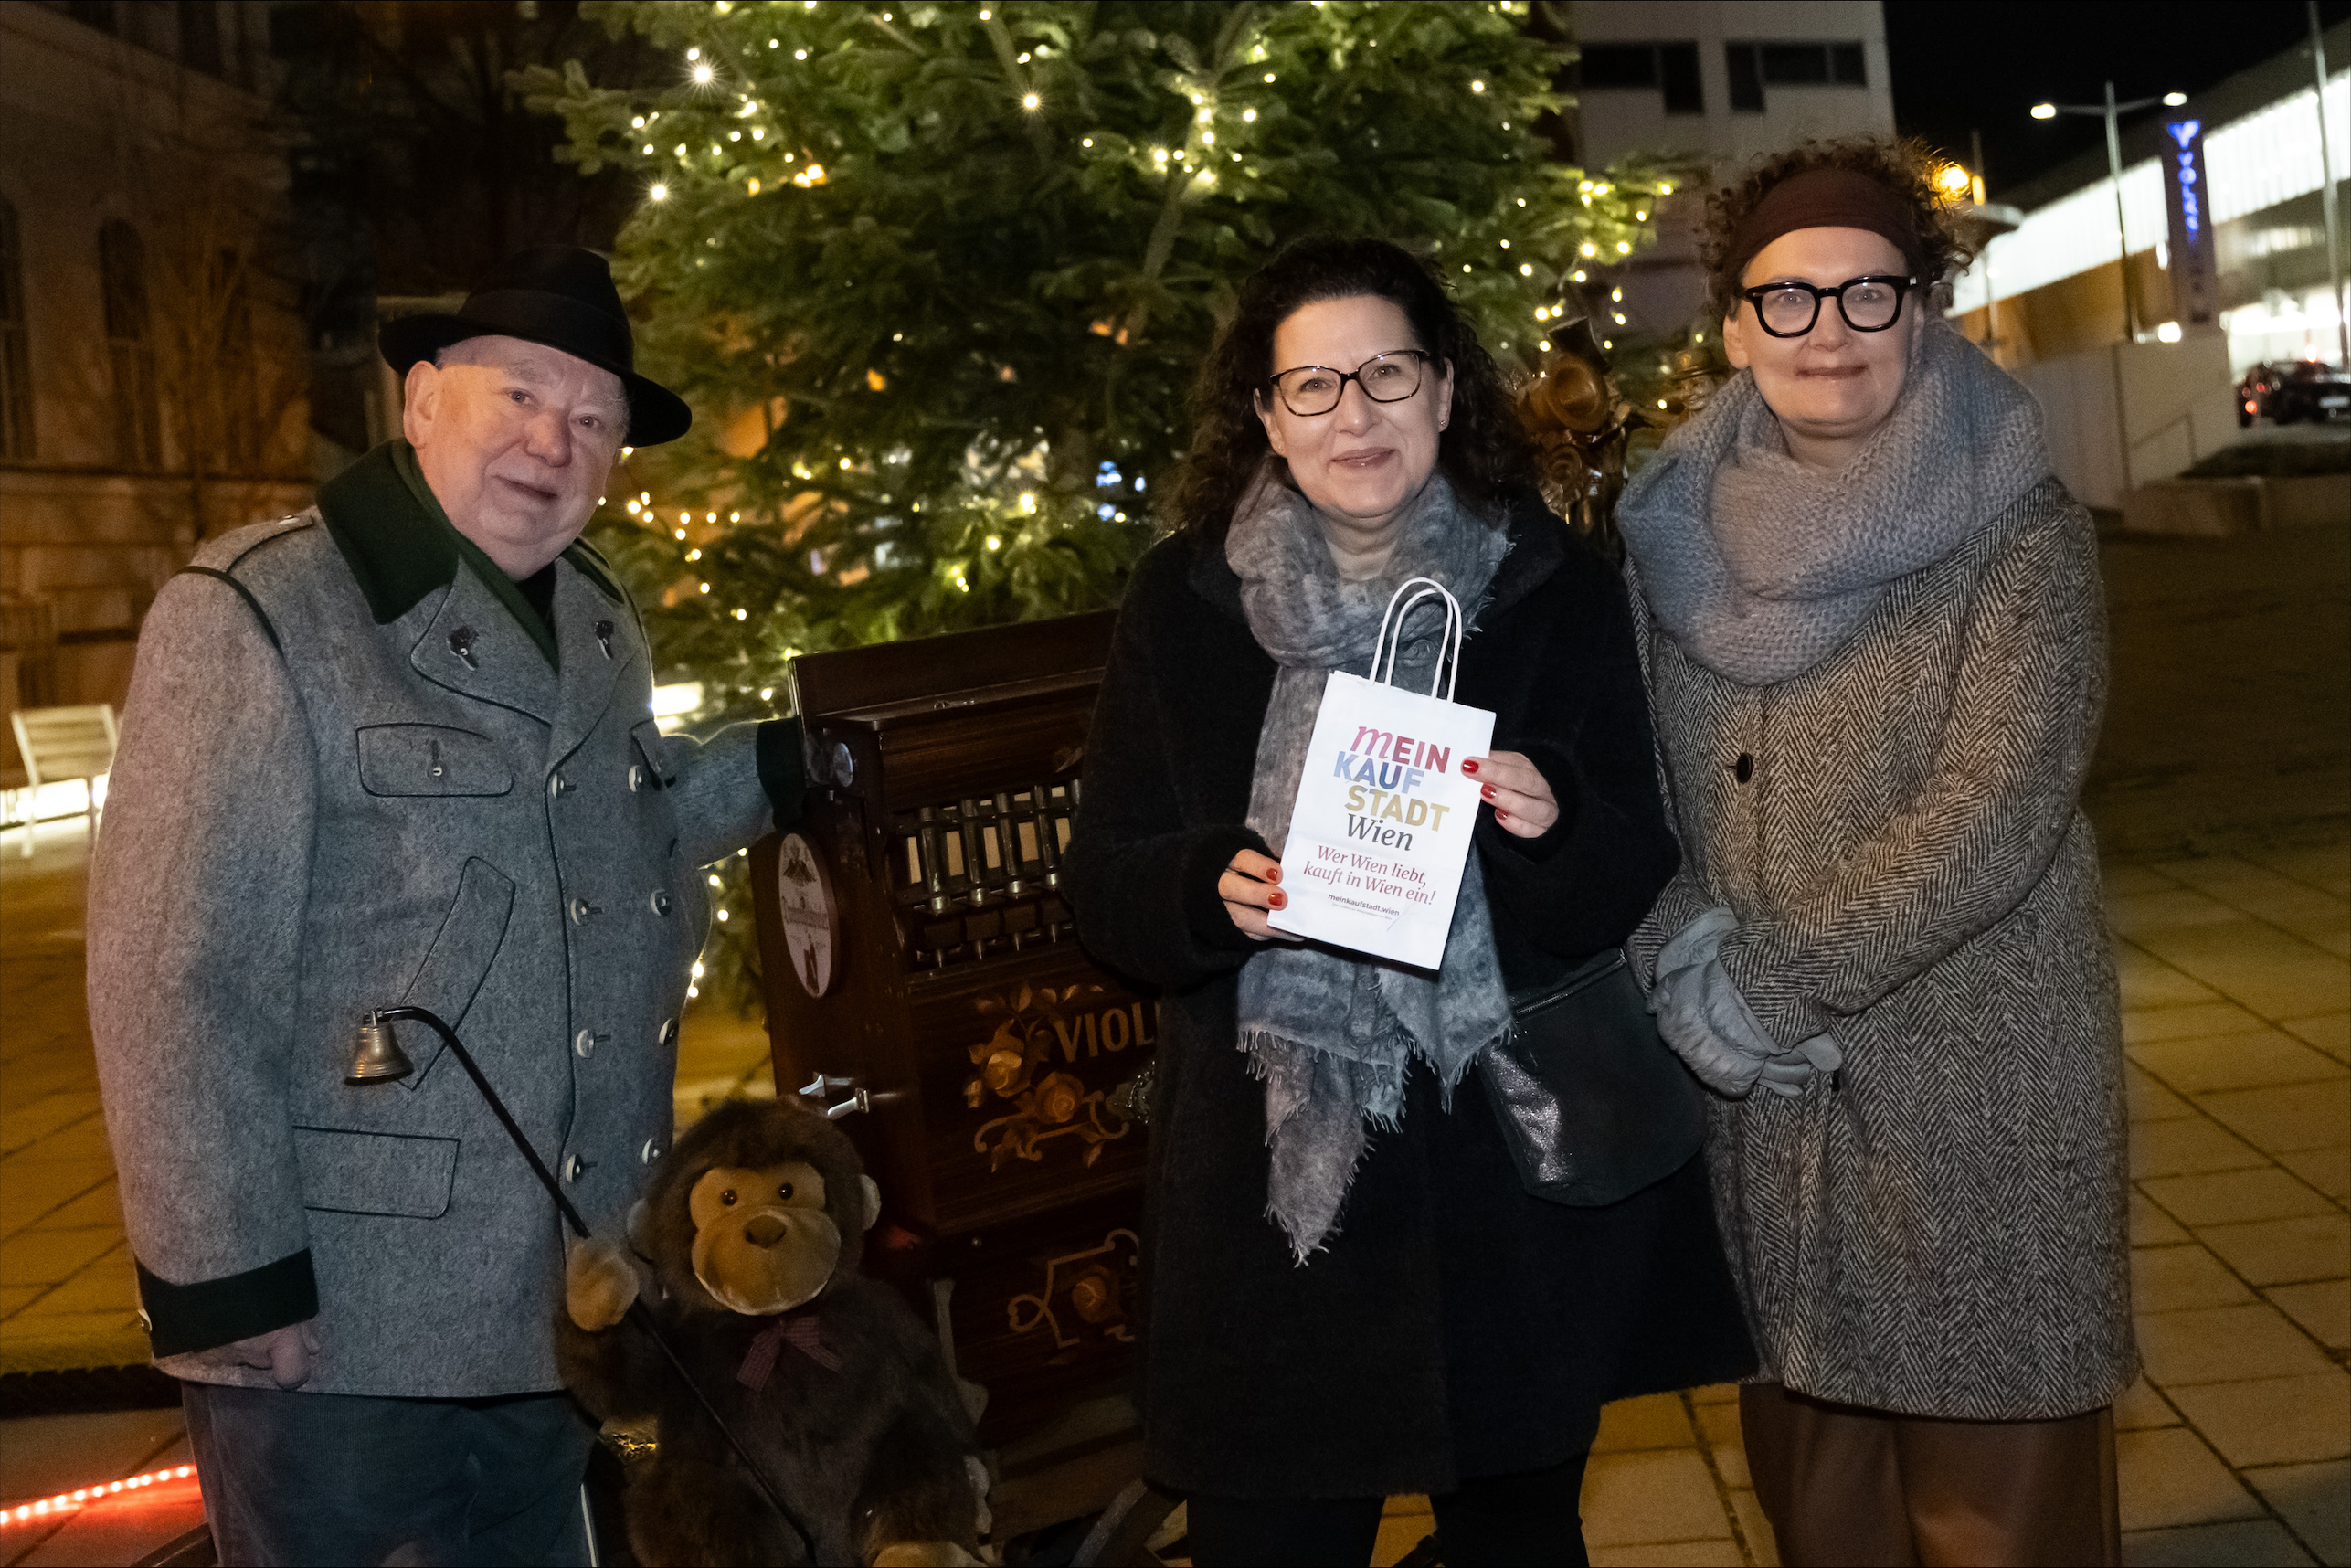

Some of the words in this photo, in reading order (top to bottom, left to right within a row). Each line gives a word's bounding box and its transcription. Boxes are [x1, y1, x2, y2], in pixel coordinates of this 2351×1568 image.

[1333, 750, 1425, 794] KAUF
[1344, 785, 1451, 832] STADT
[1348, 813, 1414, 851] Wien
[1303, 861, 1344, 885] kauft
[1346, 872, 1361, 888] in
[1365, 875, 1403, 897] Wien
[1405, 887, 1436, 906] ein!
[1318, 845, 1348, 864] Wer
[1350, 853, 1389, 875] Wien
[1391, 863, 1426, 888] liebt,
[1328, 895, 1400, 917] meinkaufstadt.wien
